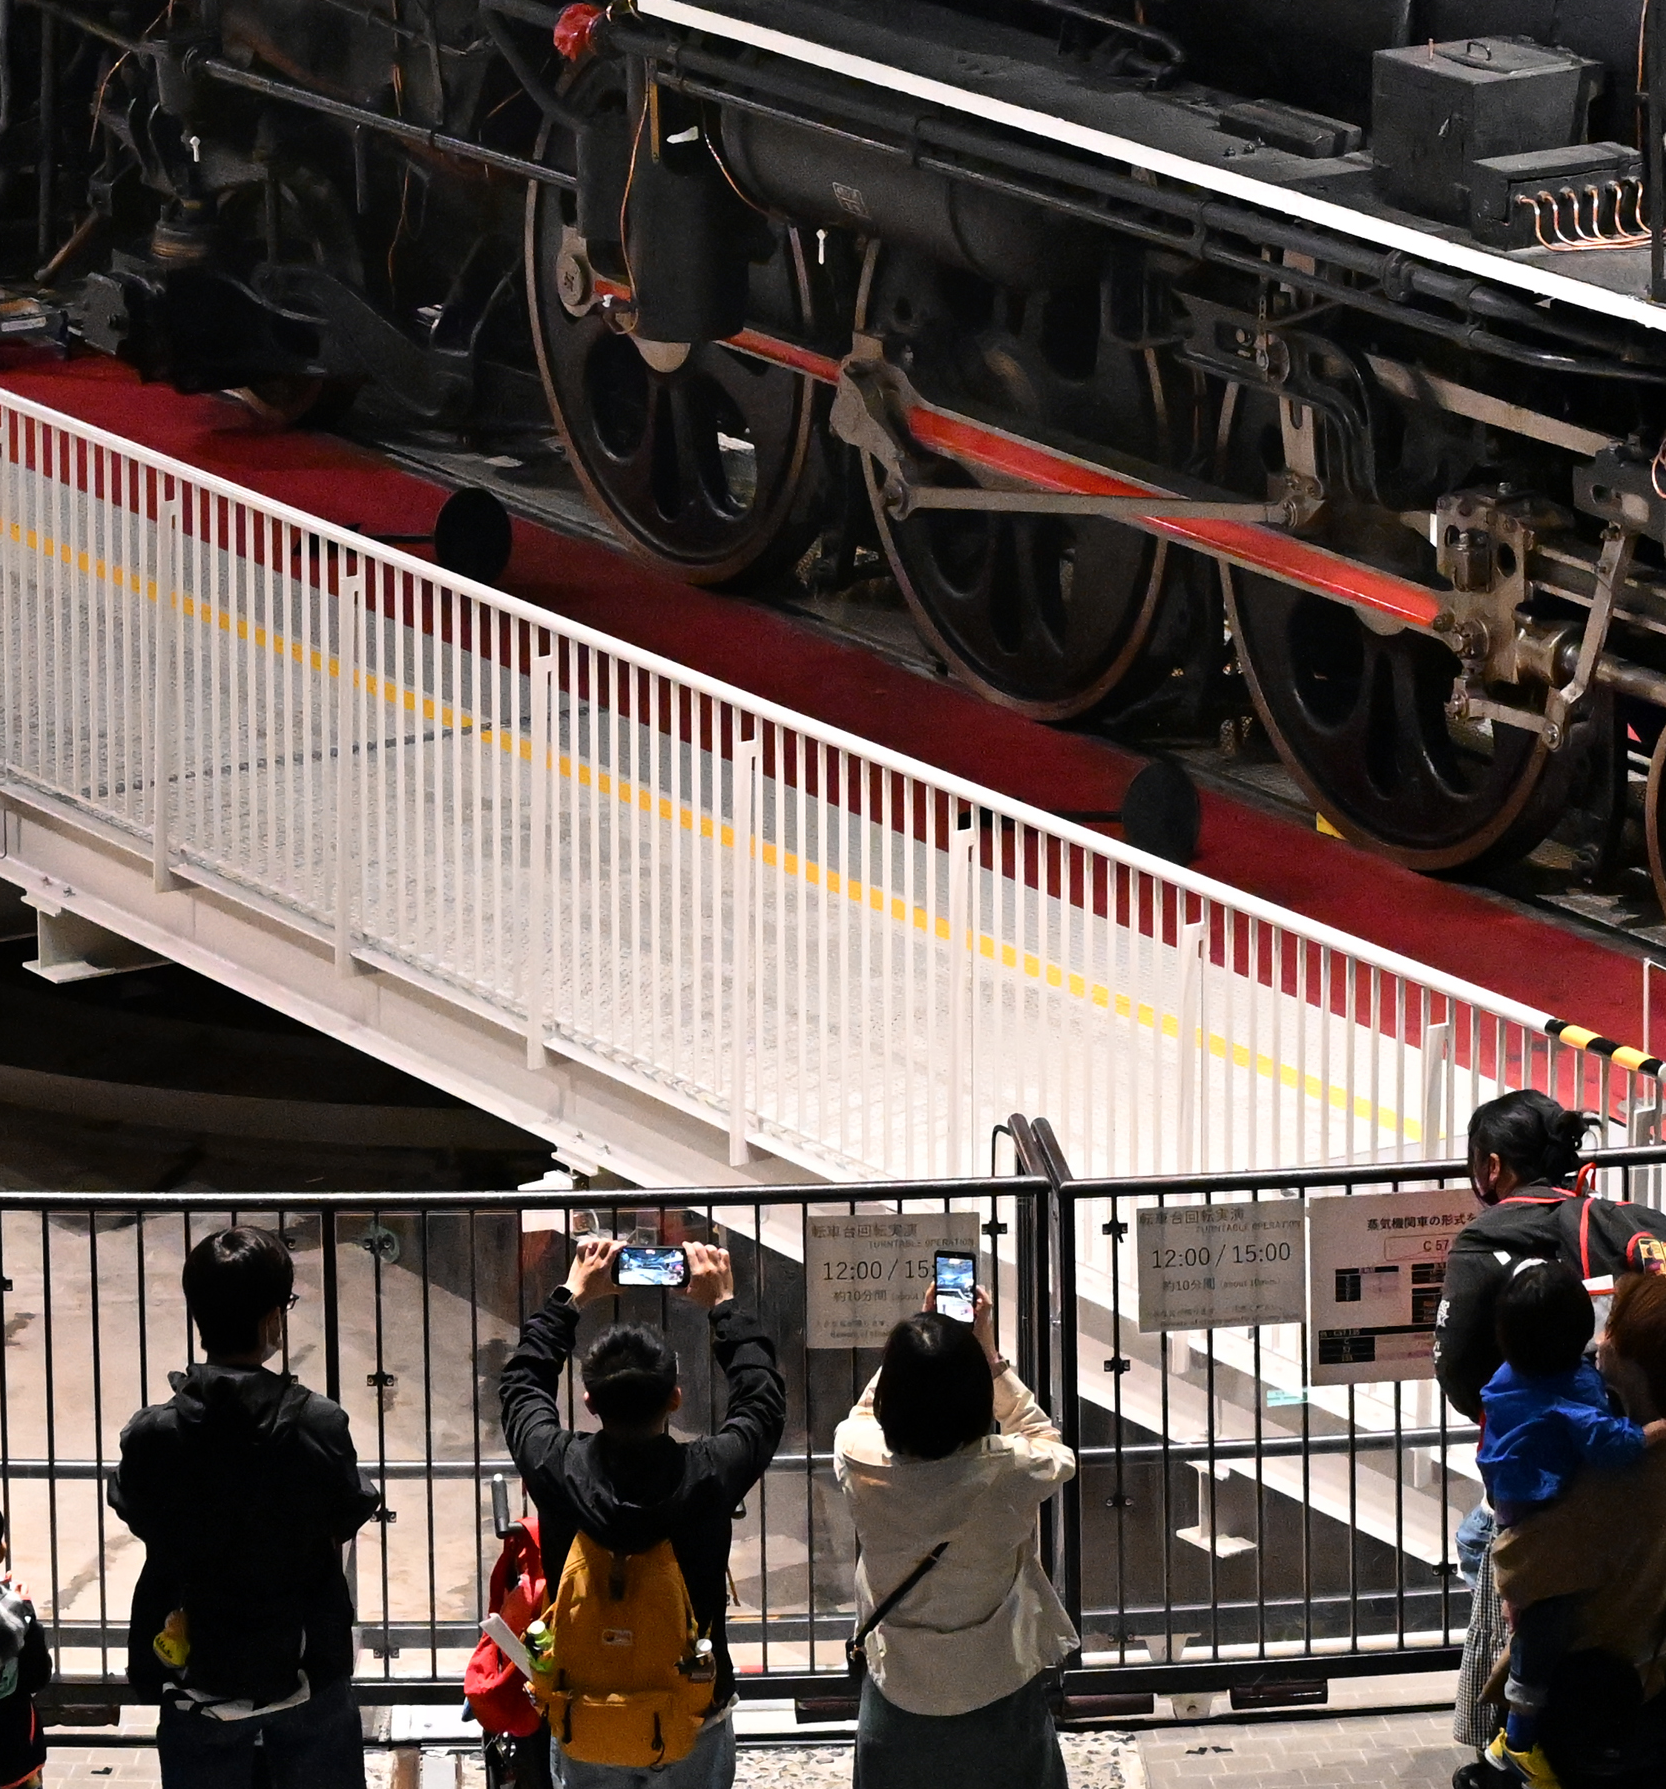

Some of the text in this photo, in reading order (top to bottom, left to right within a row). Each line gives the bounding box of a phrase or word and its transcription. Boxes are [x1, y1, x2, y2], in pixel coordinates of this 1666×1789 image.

[1152, 1247, 1210, 1269] 12:00
[1232, 1242, 1291, 1264] 15:00
[823, 1261, 882, 1281] 12:00
[905, 1260, 936, 1279] 15:
